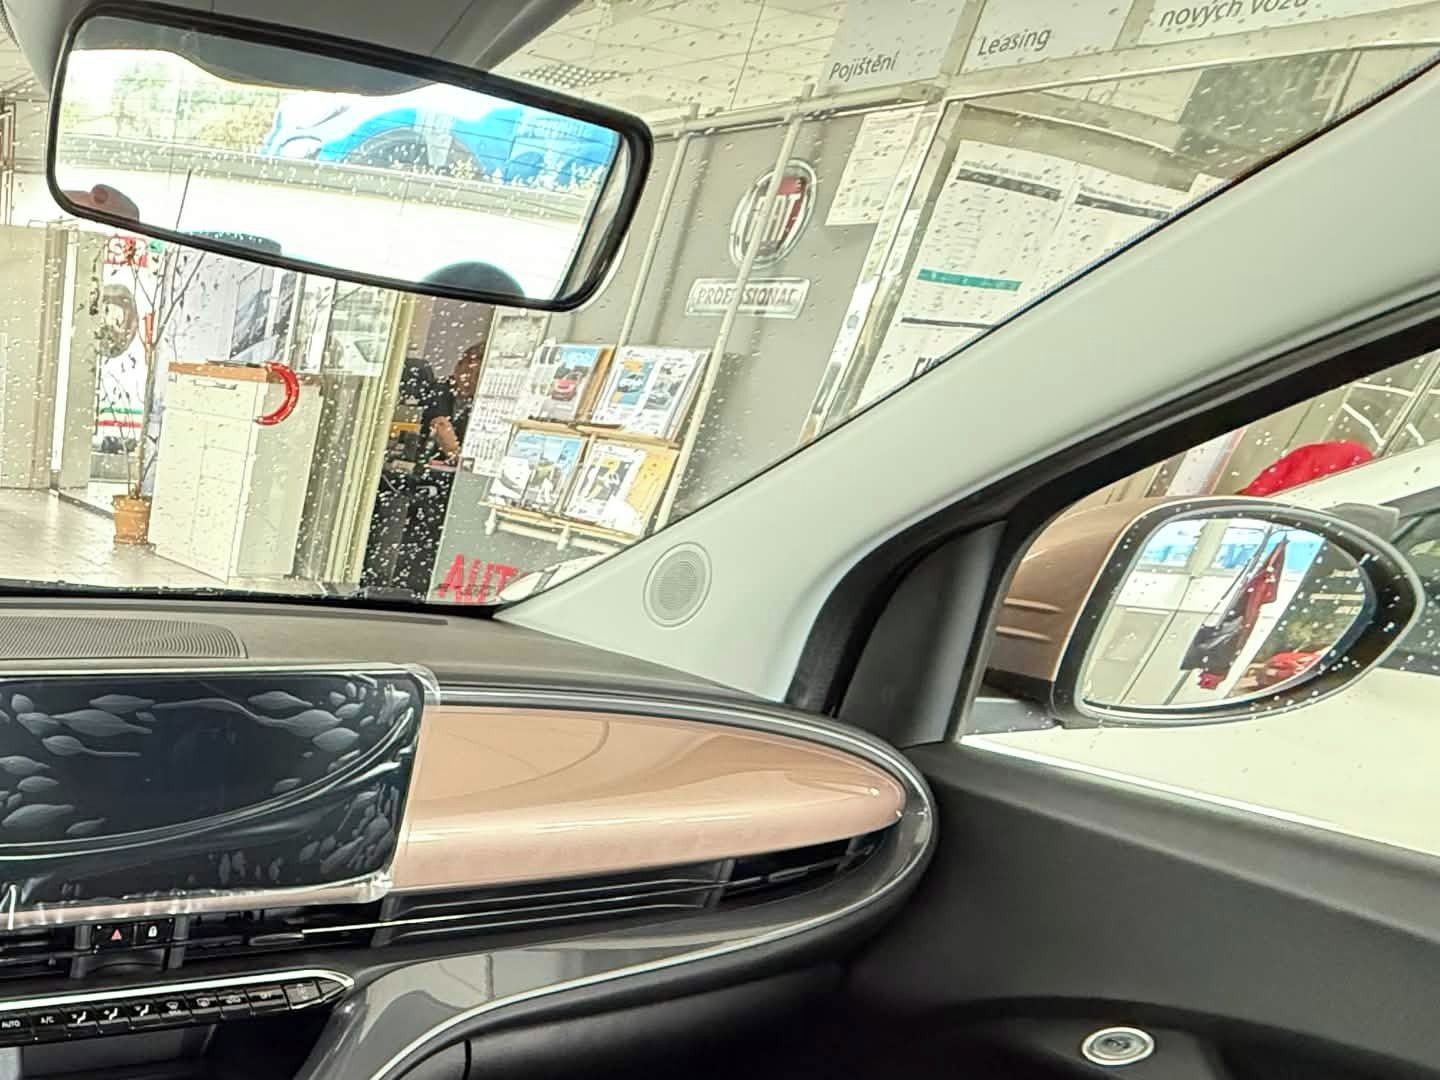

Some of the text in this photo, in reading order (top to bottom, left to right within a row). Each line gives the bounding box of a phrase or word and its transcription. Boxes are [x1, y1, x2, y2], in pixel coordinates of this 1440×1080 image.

[978, 30, 1051, 55] Leasing
[828, 51, 900, 82] Pojištění
[437, 553, 522, 603] AUT
